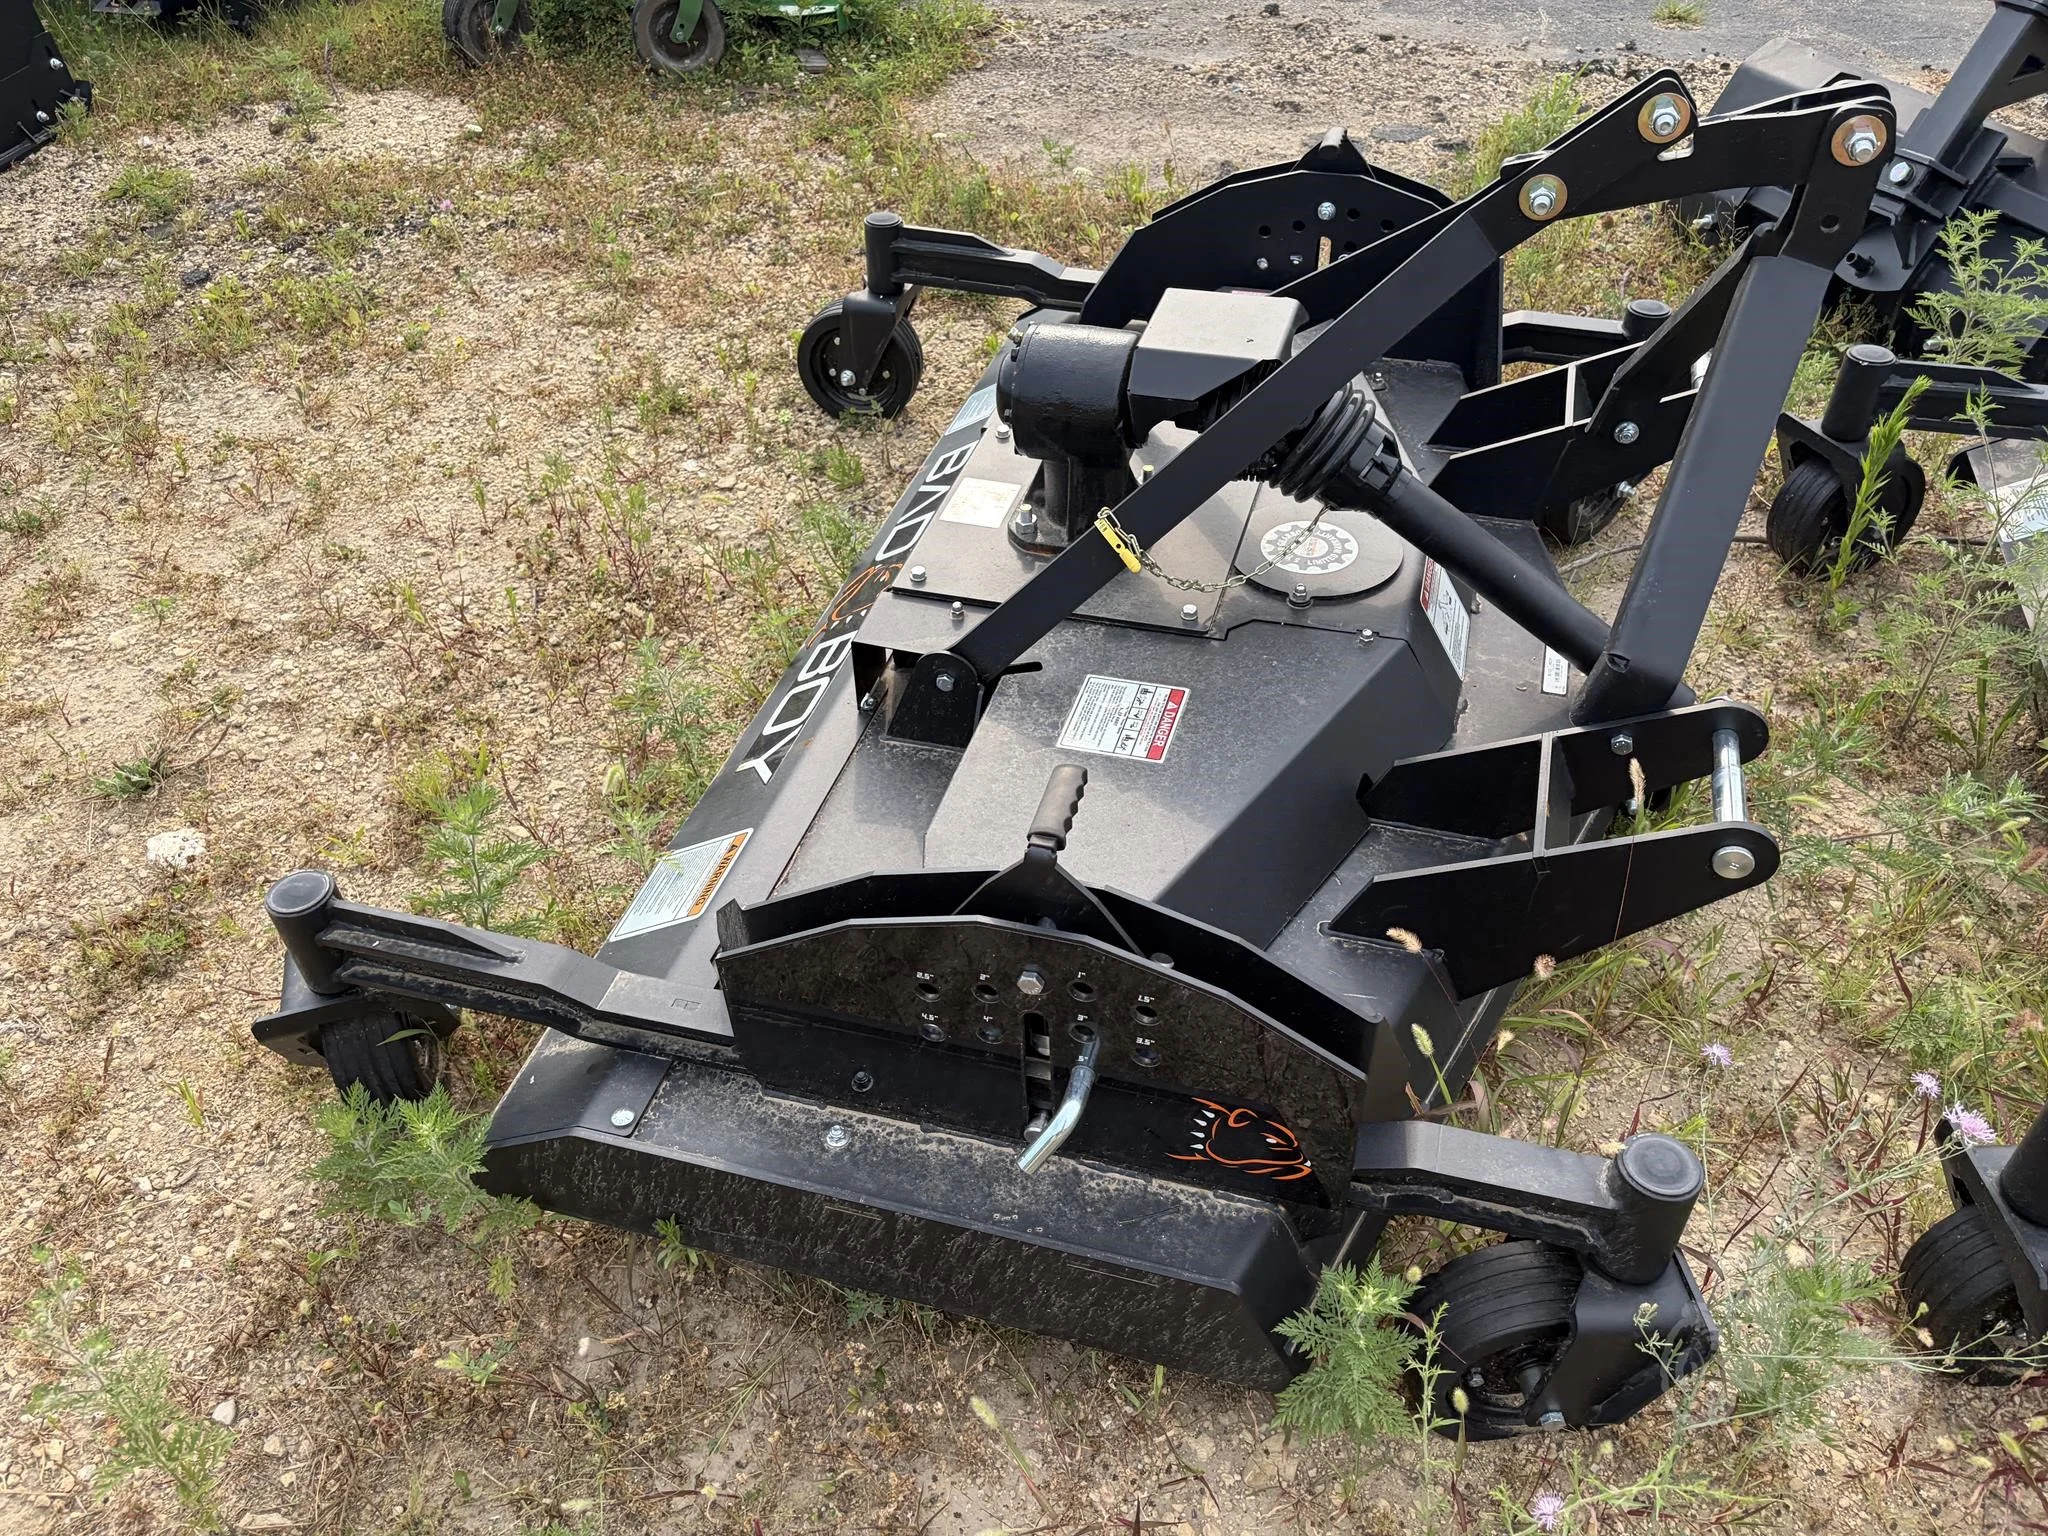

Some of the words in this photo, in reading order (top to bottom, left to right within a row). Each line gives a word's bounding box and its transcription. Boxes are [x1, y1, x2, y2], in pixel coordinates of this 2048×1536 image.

[875, 440, 979, 561] BAD
[736, 630, 858, 784] BOY
[1154, 711, 1176, 747] DANGER
[695, 855, 733, 906] WARNING
